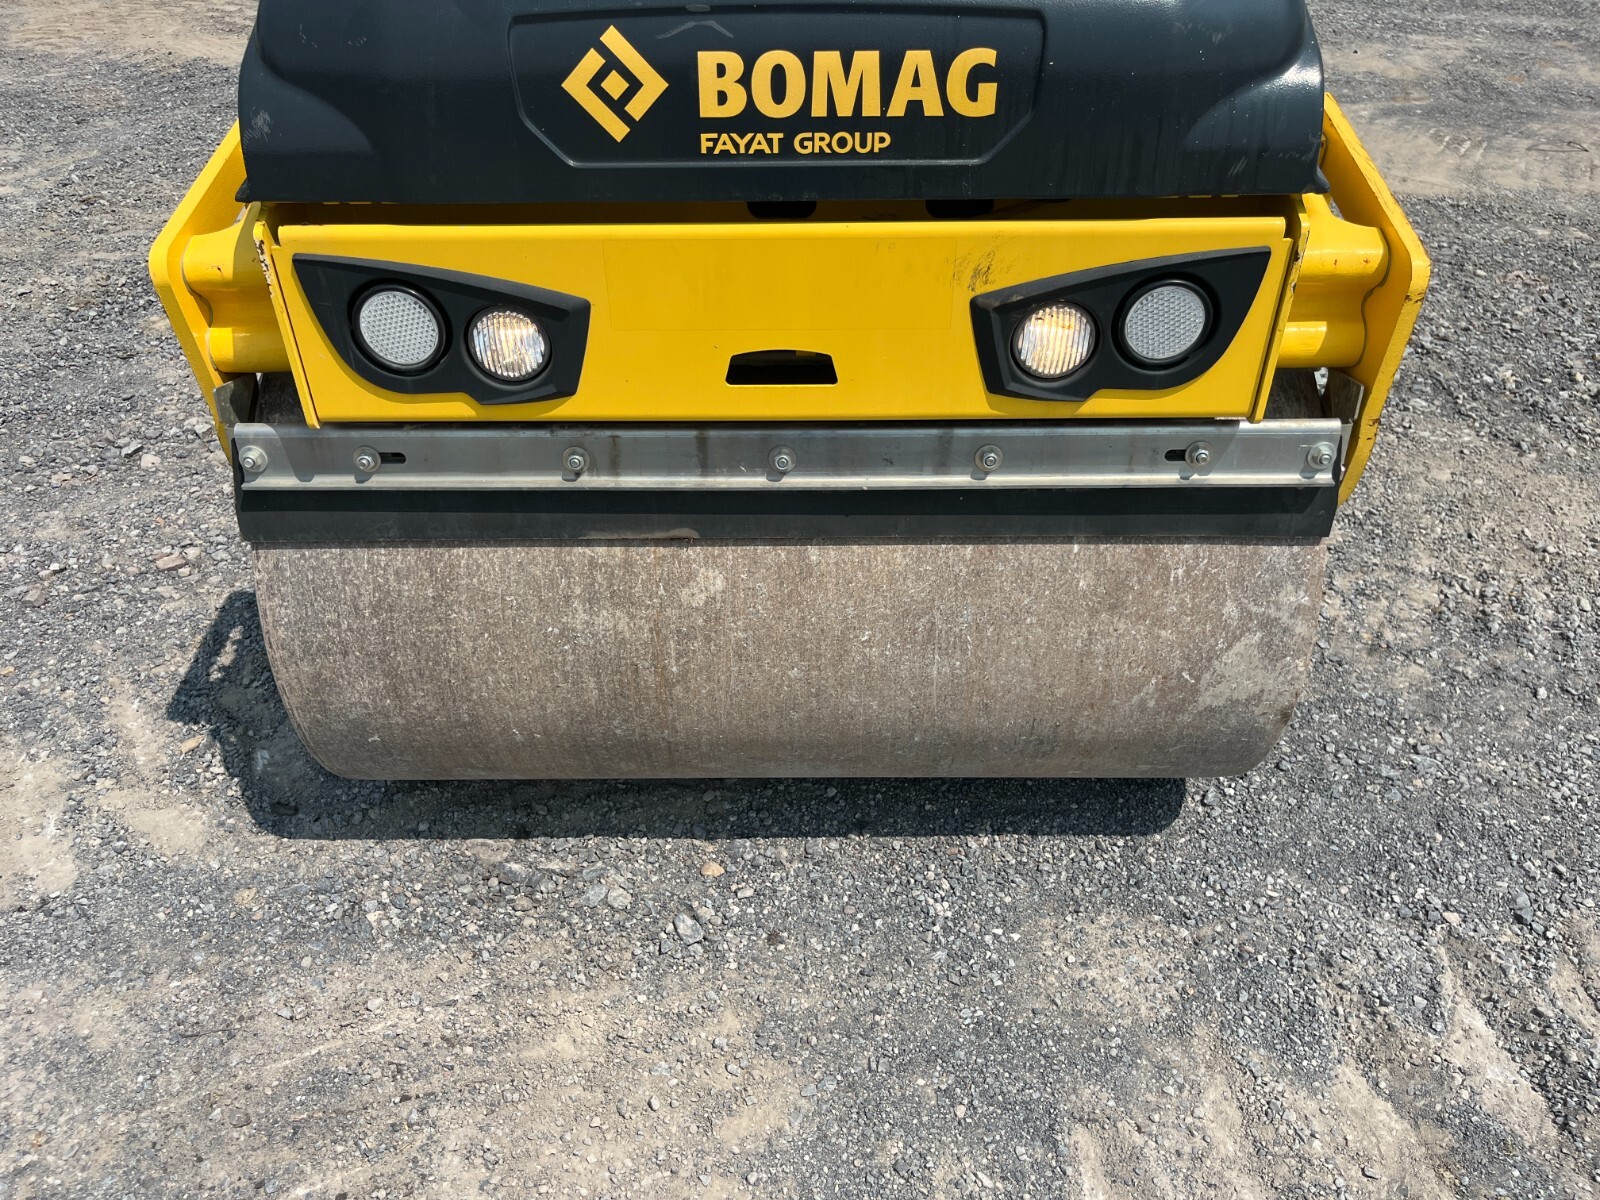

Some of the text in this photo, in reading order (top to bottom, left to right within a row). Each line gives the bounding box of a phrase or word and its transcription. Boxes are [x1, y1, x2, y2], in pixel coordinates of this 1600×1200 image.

[698, 48, 998, 119] BOMAG
[700, 131, 892, 154] FAYAT GROUP
